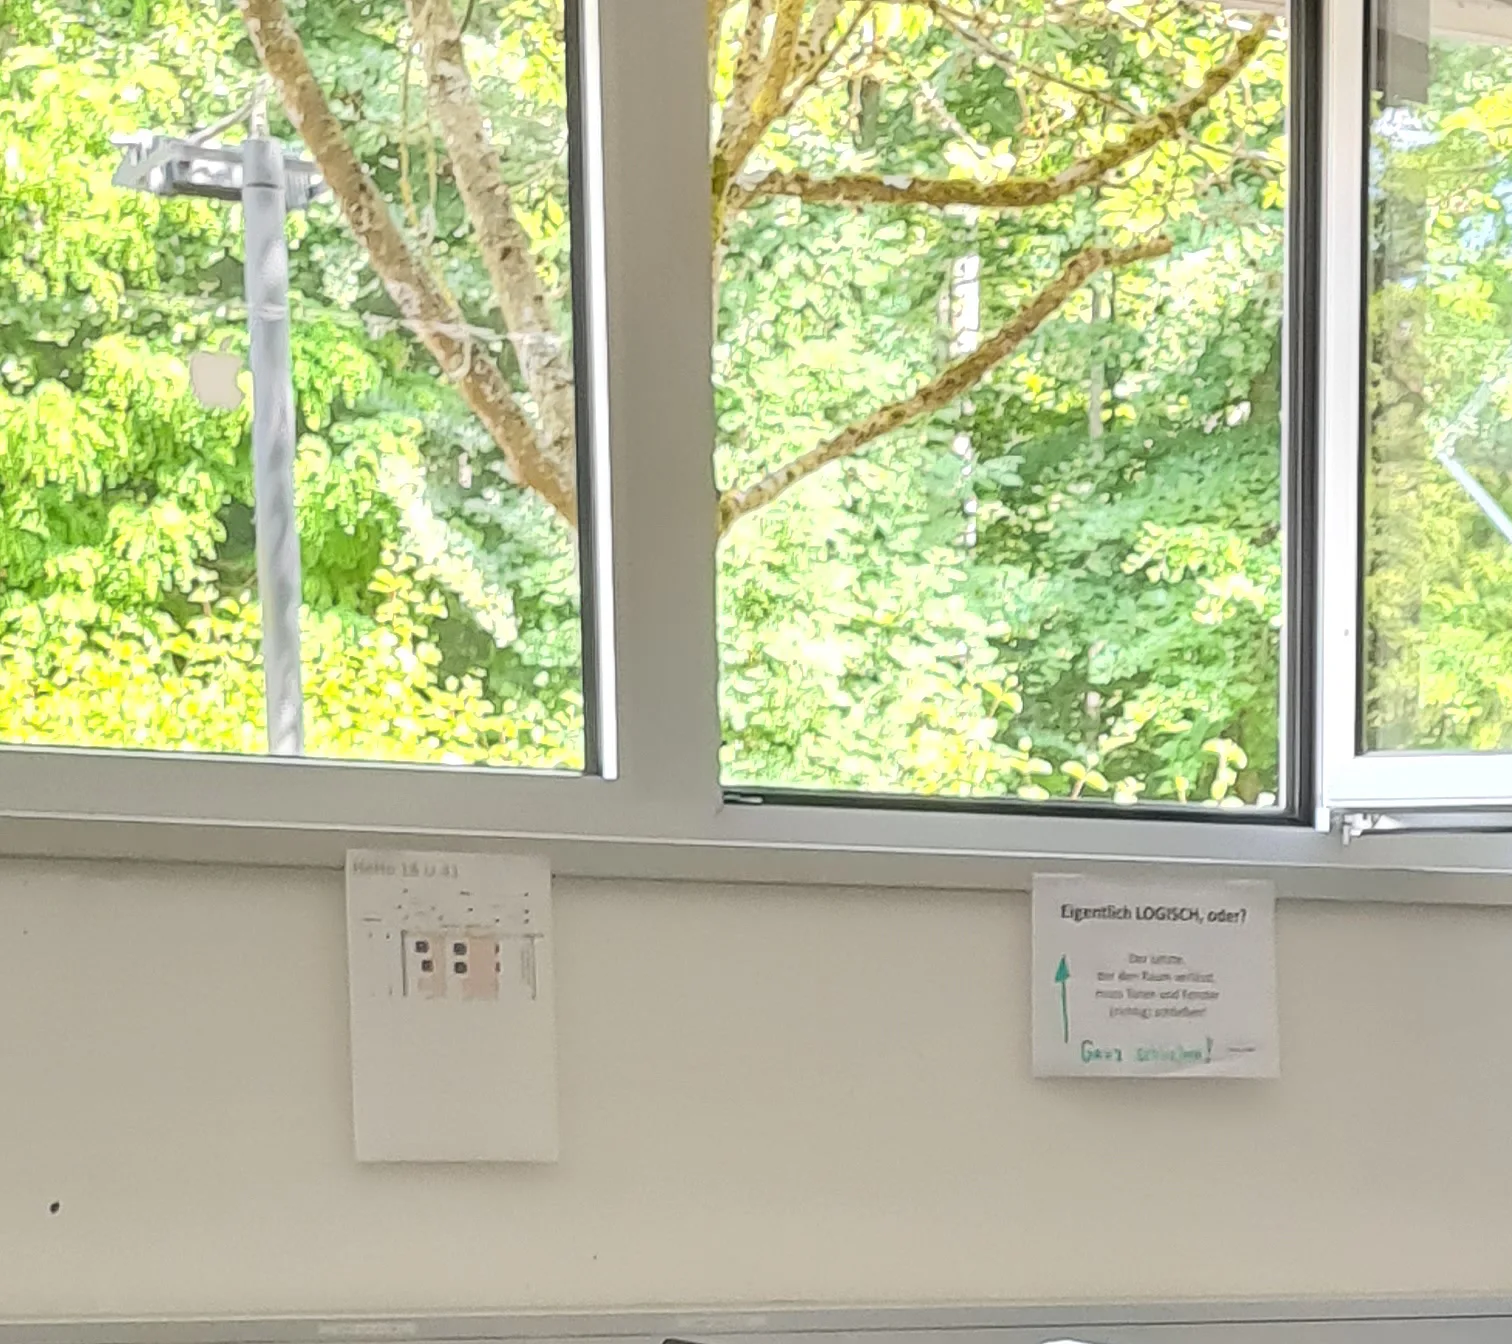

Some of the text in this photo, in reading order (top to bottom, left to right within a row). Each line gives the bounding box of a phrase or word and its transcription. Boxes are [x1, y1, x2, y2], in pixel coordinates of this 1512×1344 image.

[1060, 903, 1247, 925] Eigentlich LOGISCH, oder?
